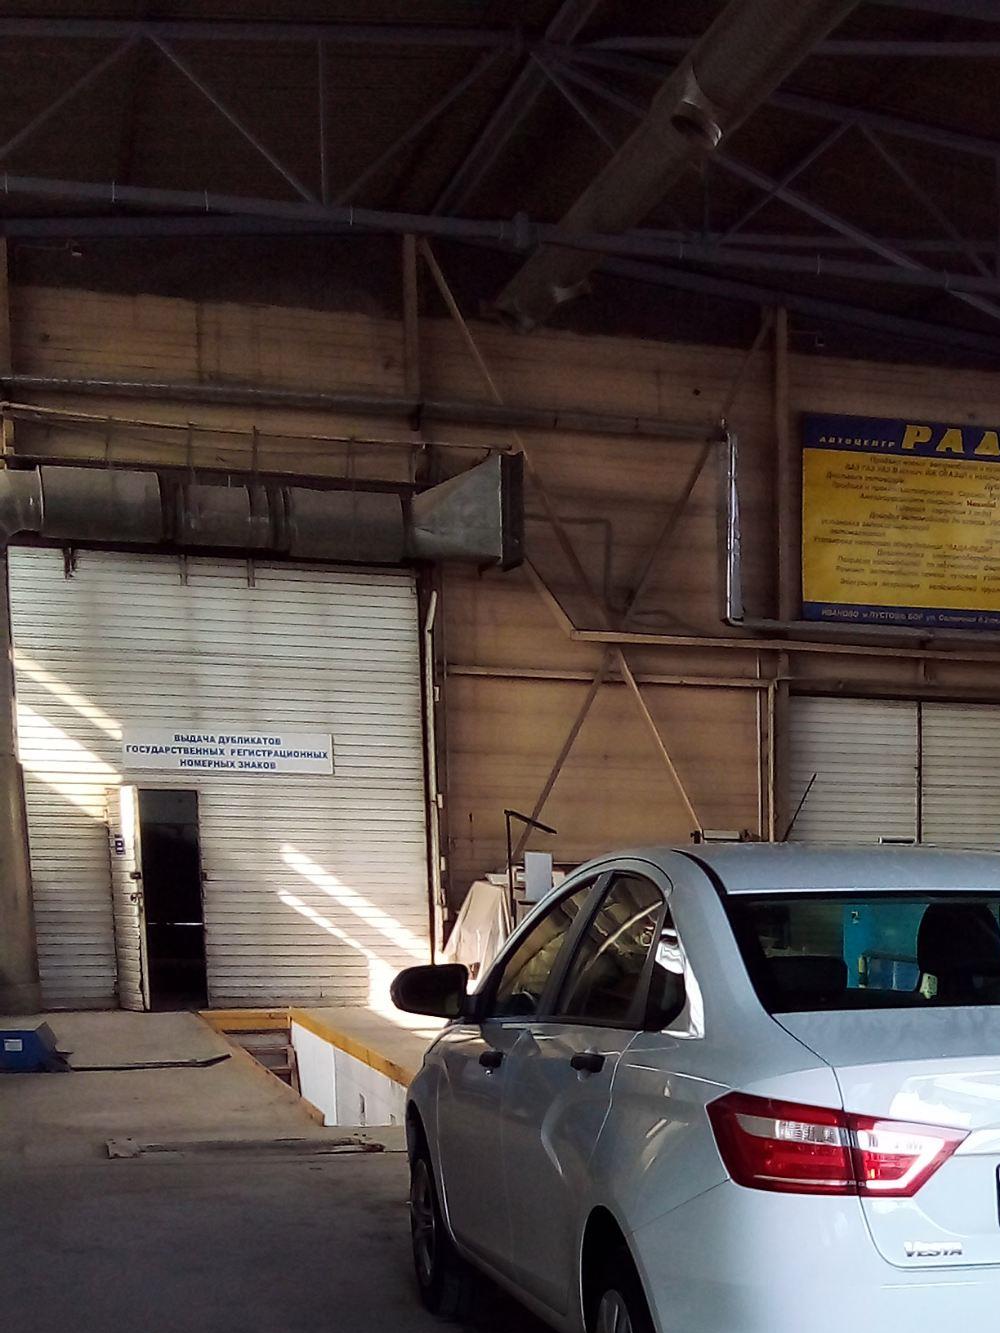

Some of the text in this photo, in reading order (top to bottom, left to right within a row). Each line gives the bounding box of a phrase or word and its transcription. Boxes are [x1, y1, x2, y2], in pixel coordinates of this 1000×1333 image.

[174, 734, 281, 746] ВЫДАЧА ДУБЛИКАТОВ
[126, 744, 328, 759] ГОСУДАРСТВЕННЫХ РЕГИСТРАЦИОННЫХ
[180, 758, 276, 770] НОМЕРНЫХ ЗНАКОВ
